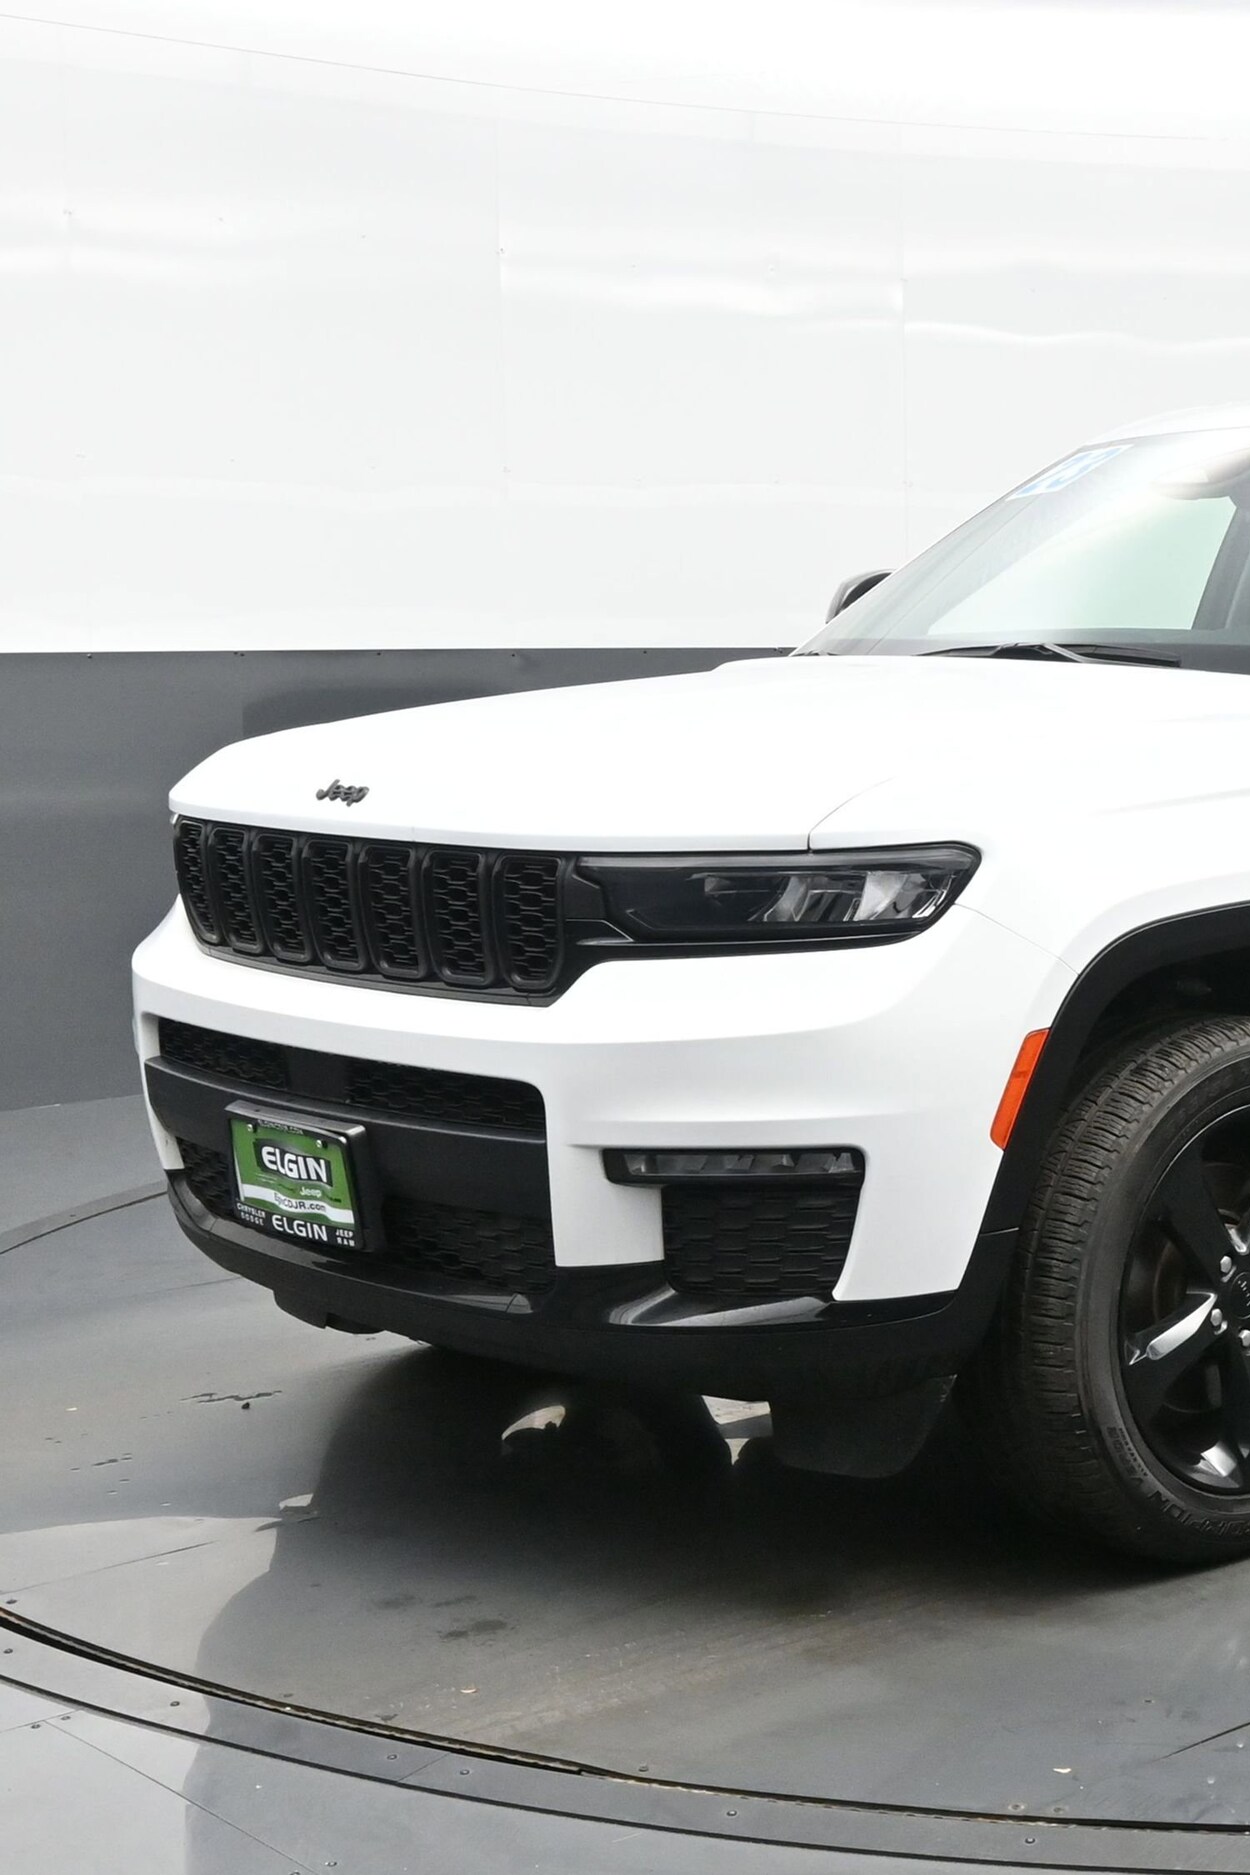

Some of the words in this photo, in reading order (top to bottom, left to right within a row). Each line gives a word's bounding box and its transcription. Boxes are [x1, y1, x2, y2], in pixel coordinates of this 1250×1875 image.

[316, 779, 370, 807] Jeep
[262, 1146, 327, 1183] ELGIN
[300, 1187, 322, 1198] Jeep
[237, 1203, 266, 1218] CHRYSLER
[241, 1212, 264, 1226] DODGE
[271, 1215, 328, 1242] ELGIN
[335, 1229, 353, 1238] JEEP
[337, 1237, 355, 1247] RAM
